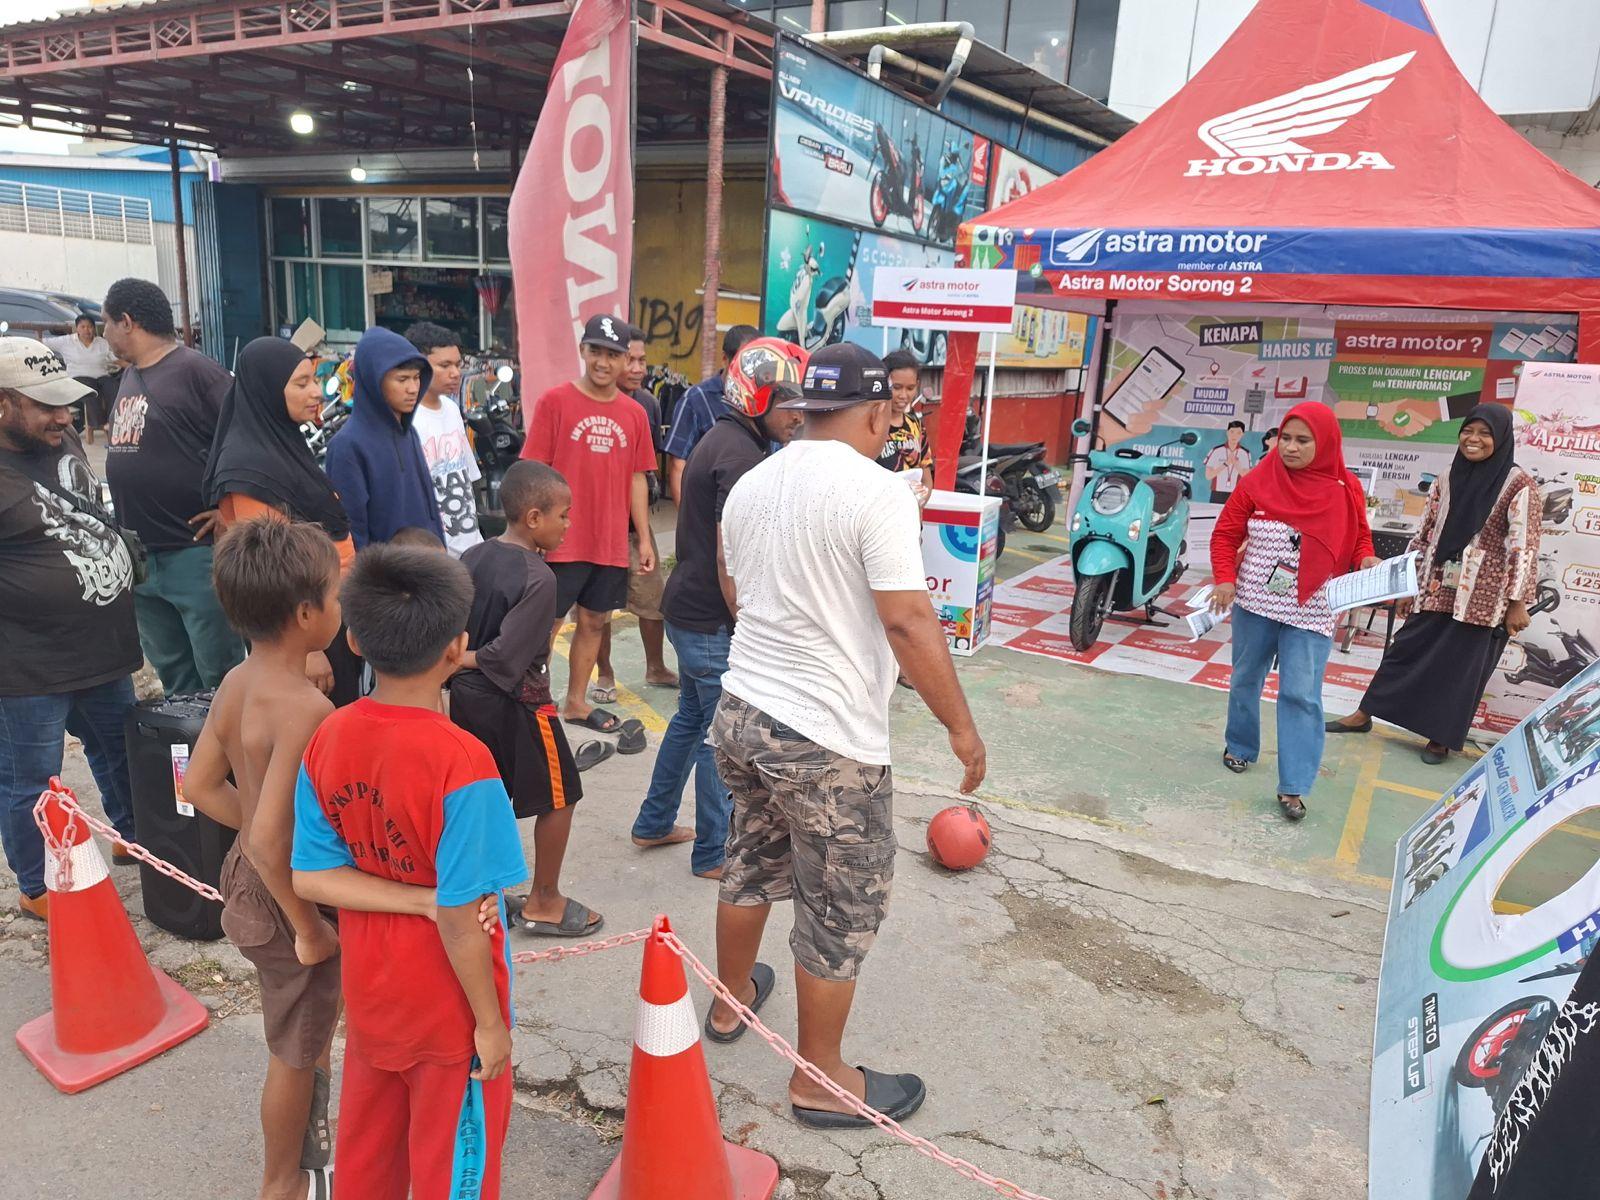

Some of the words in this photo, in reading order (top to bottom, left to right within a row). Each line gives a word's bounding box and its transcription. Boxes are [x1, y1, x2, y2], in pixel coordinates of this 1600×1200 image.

[1183, 151, 1395, 176] HONDA
[1105, 230, 1174, 253] astra
[1179, 230, 1268, 253] motor
[1178, 261, 1215, 271] member
[1217, 261, 1228, 271] of
[1229, 262, 1262, 271] ASTRA
[919, 279, 945, 290] astra
[947, 281, 979, 291] motor
[1058, 273, 1104, 290] Astra
[1109, 275, 1163, 291] Motor
[1167, 275, 1235, 296] Sorong
[1239, 276, 1253, 294] 2
[902, 306, 920, 314] Astra
[921, 307, 941, 316] Motor
[943, 308, 967, 318] Sorong
[1203, 325, 1258, 343] KENAPA
[1262, 343, 1310, 358] HARUS
[1314, 342, 1333, 357] KE
[1345, 334, 1397, 349] astra
[1401, 336, 1466, 351] motor
[1471, 337, 1483, 353] ?
[1339, 365, 1367, 375] PROSES
[1368, 366, 1383, 375] DAN
[1385, 367, 1421, 377] DOKUMEN
[1423, 369, 1472, 382] LENGKAP
[1567, 373, 1592, 381] MOTOR
[1372, 380, 1386, 388] DAN
[1387, 380, 1452, 391] TERINFORMASI
[1195, 389, 1226, 399] MUDAH
[1186, 402, 1233, 414] DITEMUKAN
[591, 425, 612, 436] AND
[586, 434, 614, 447] FITCH
[1384, 452, 1420, 461] LENGKAP
[1362, 460, 1394, 470] NYAMAN
[1382, 471, 1411, 480] BERSIH
[1564, 594, 1600, 605] SCOO
[1424, 996, 1437, 1026] TIME
[1407, 1016, 1419, 1060] STEP
[1425, 1026, 1438, 1044] TO
[1407, 1061, 1420, 1088] UP
[459, 1167, 479, 1200] SOR
